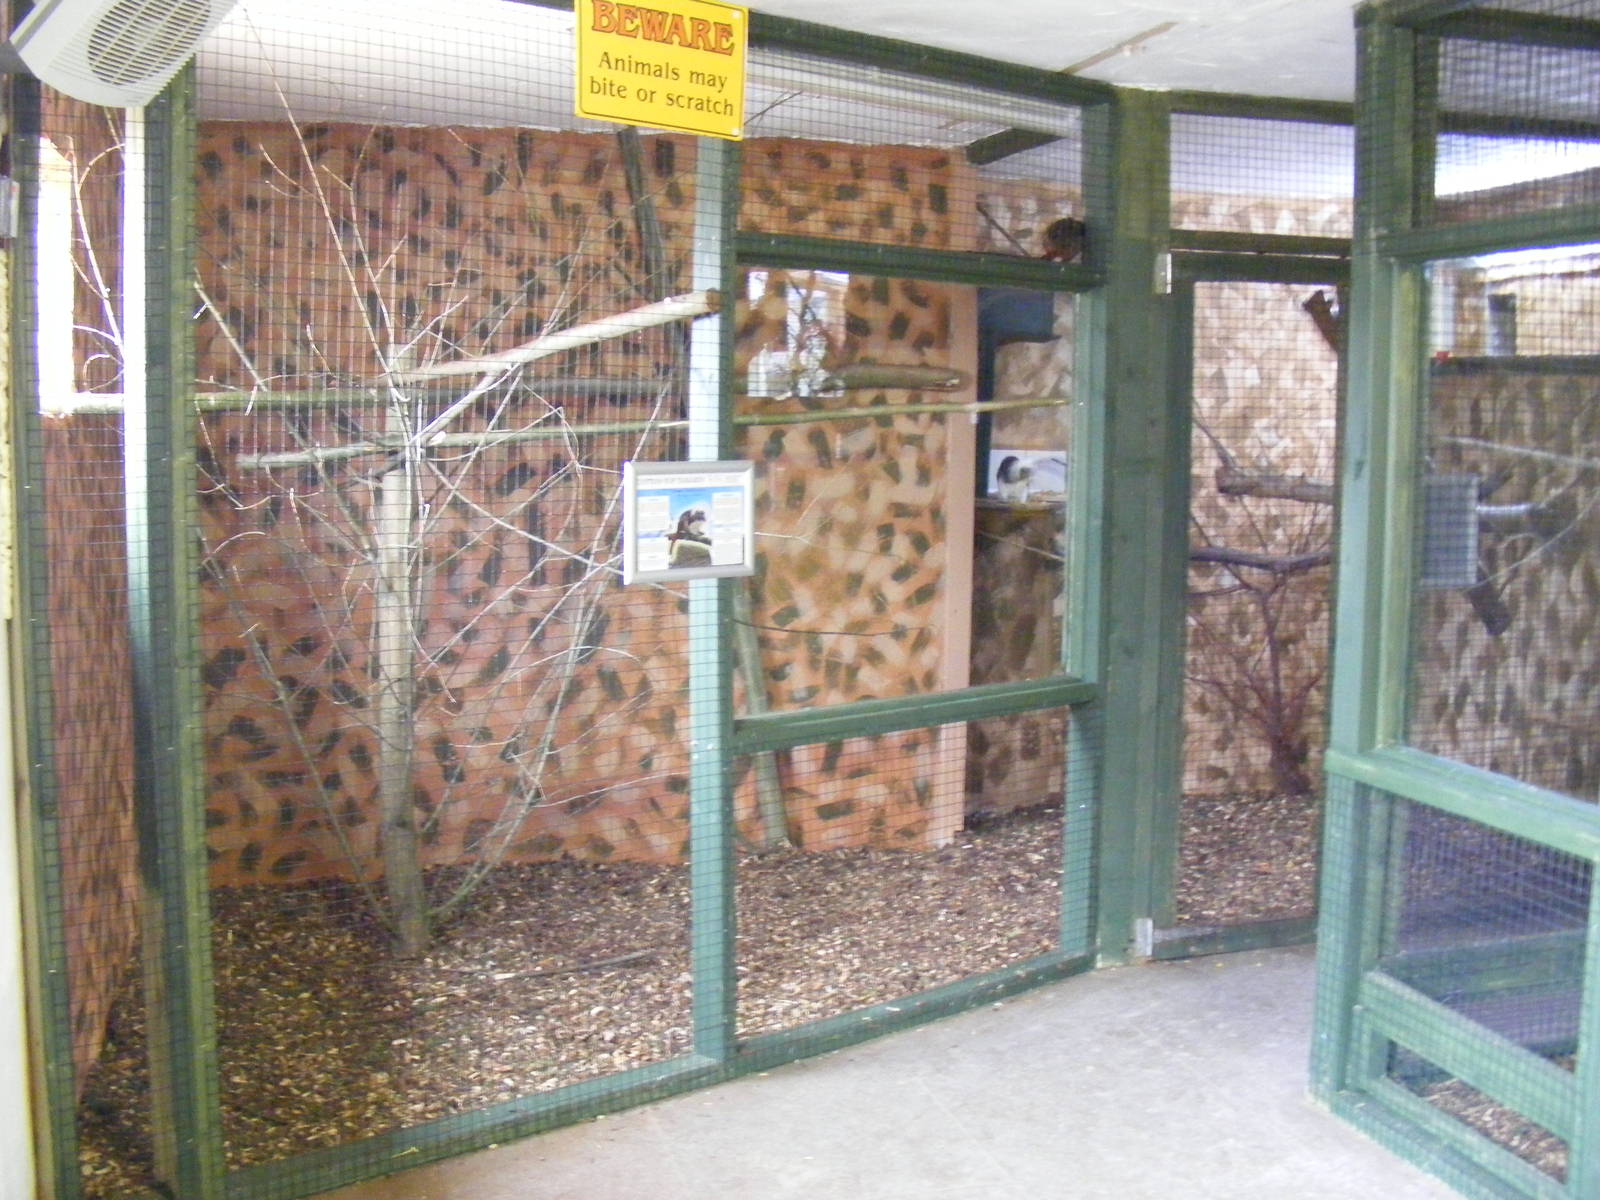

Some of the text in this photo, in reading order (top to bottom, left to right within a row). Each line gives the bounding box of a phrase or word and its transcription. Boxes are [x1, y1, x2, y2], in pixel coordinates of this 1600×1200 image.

[592, 0, 735, 56] BEWARE
[598, 51, 728, 93] Animals may
[590, 76, 734, 116] bite or scratch
